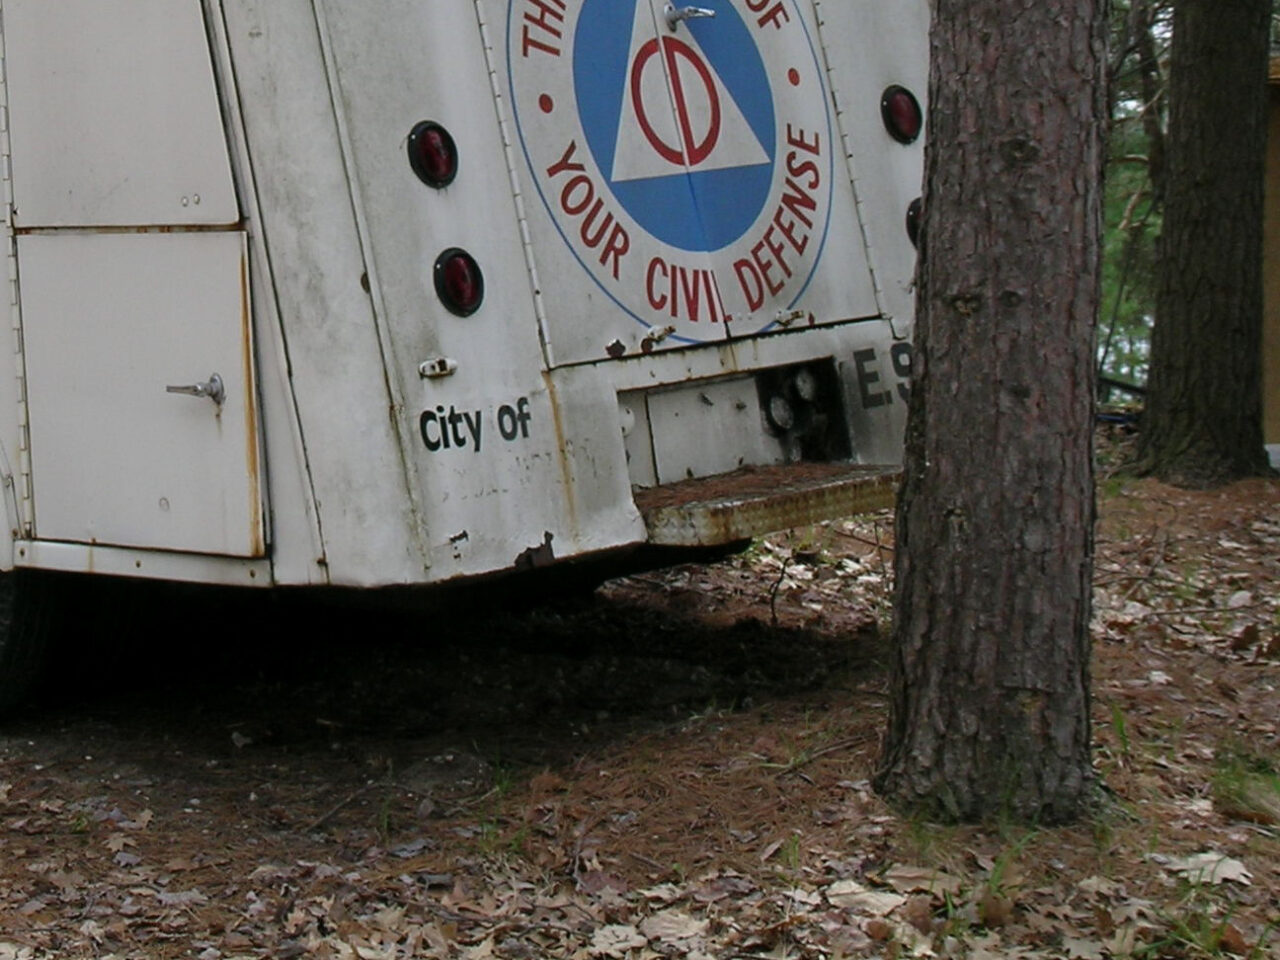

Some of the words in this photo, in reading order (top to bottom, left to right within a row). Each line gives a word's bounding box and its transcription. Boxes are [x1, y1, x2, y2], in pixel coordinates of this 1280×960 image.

[546, 140, 630, 279] YOUR
[646, 256, 732, 323] CIVIL
[733, 123, 820, 312] DEFENSE
[420, 404, 482, 452] City
